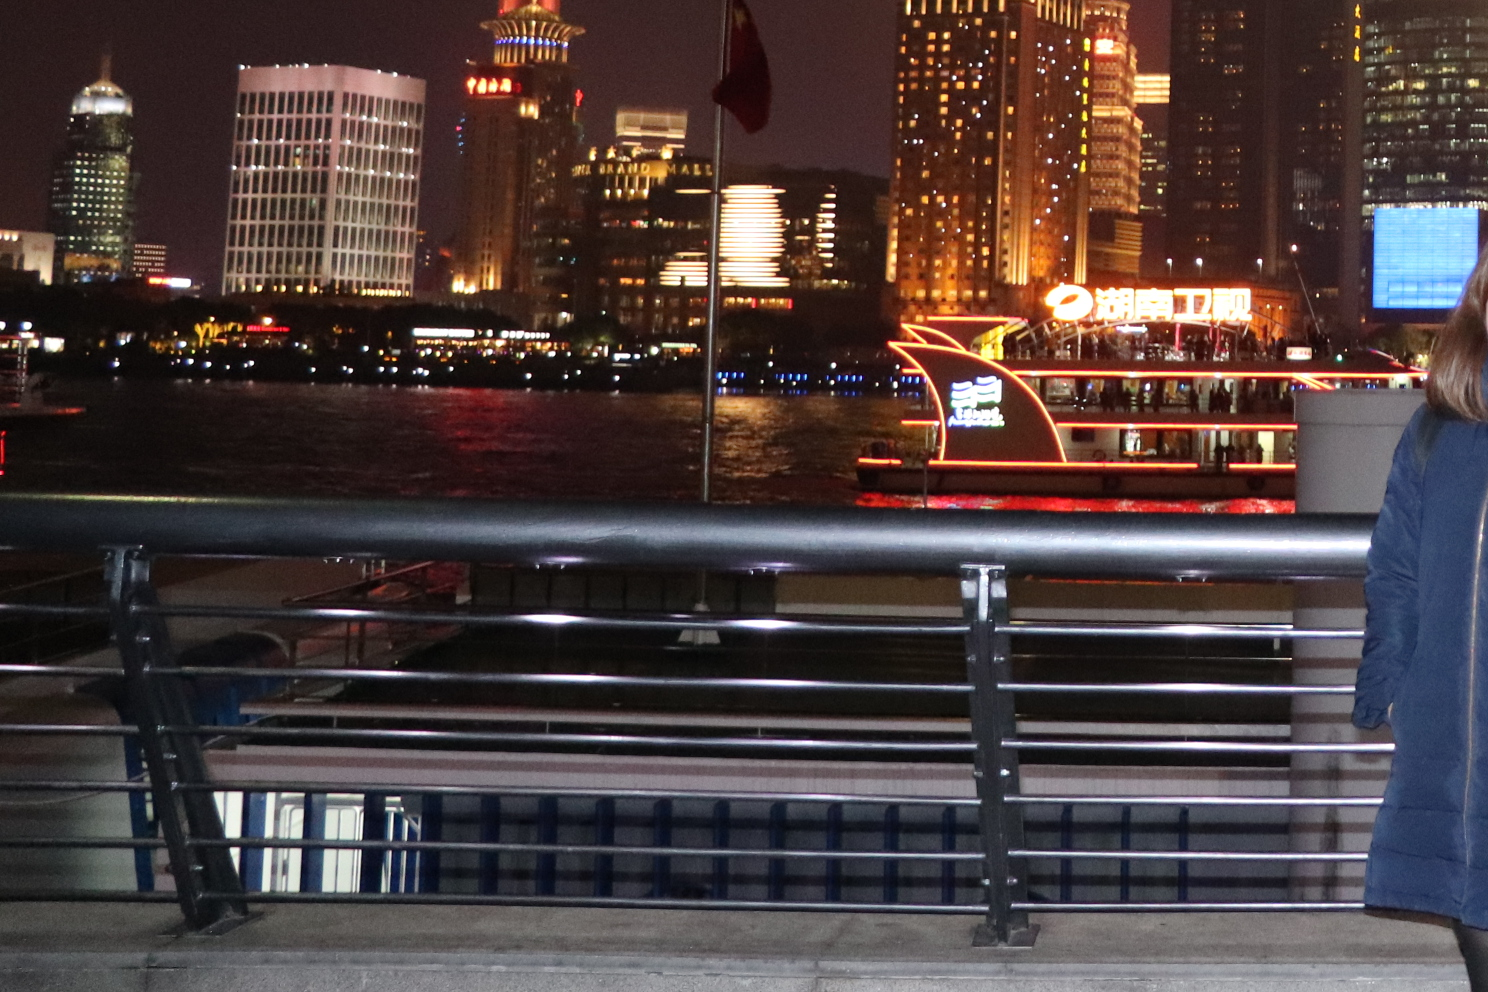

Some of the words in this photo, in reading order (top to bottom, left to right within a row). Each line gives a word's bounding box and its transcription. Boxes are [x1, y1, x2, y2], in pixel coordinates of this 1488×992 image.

[599, 163, 651, 175] BRAND
[667, 164, 713, 176] MALL
[1095, 287, 1253, 321] 湖南卫视
